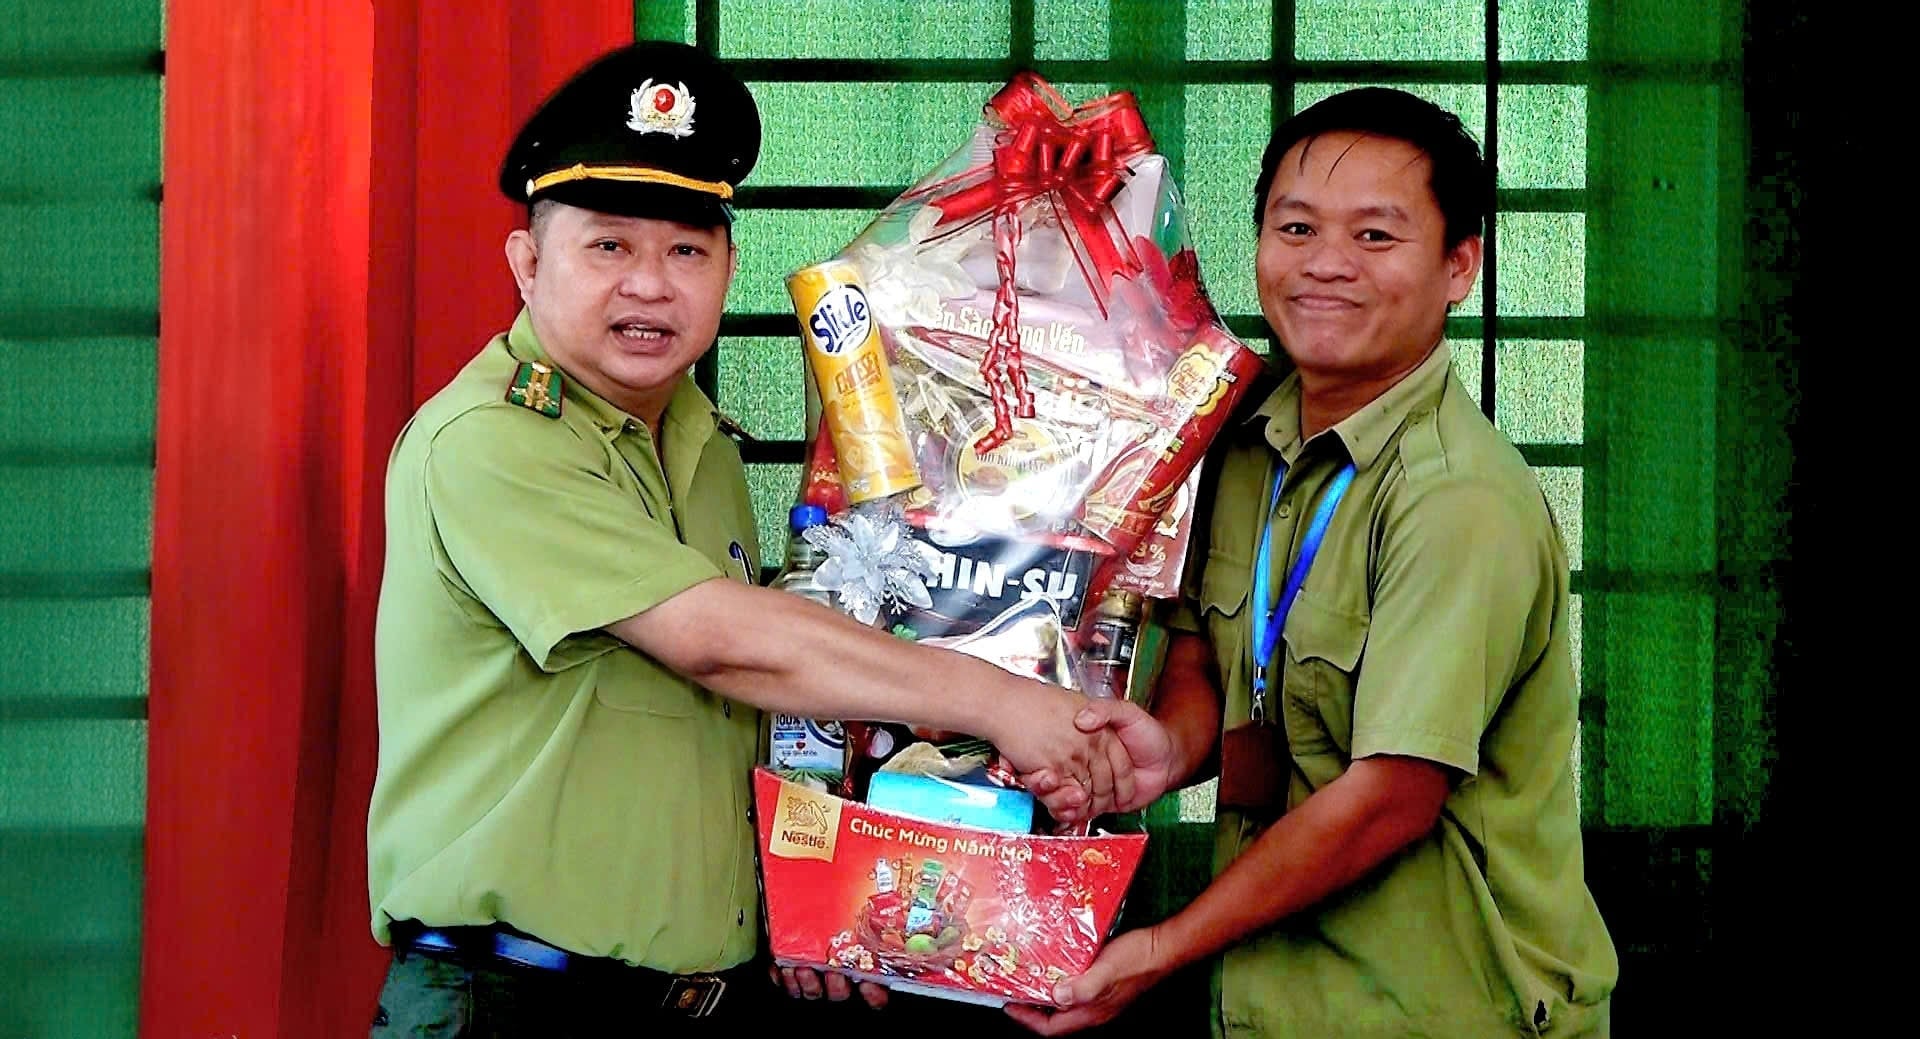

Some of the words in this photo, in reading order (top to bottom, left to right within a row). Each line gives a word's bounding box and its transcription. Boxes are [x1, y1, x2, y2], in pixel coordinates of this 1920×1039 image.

[1049, 320, 1085, 353] Yến
[925, 552, 1078, 600] HIN-SU
[849, 817, 894, 840] Chúc
[899, 828, 949, 853] Mừng
[953, 838, 996, 857] Năm
